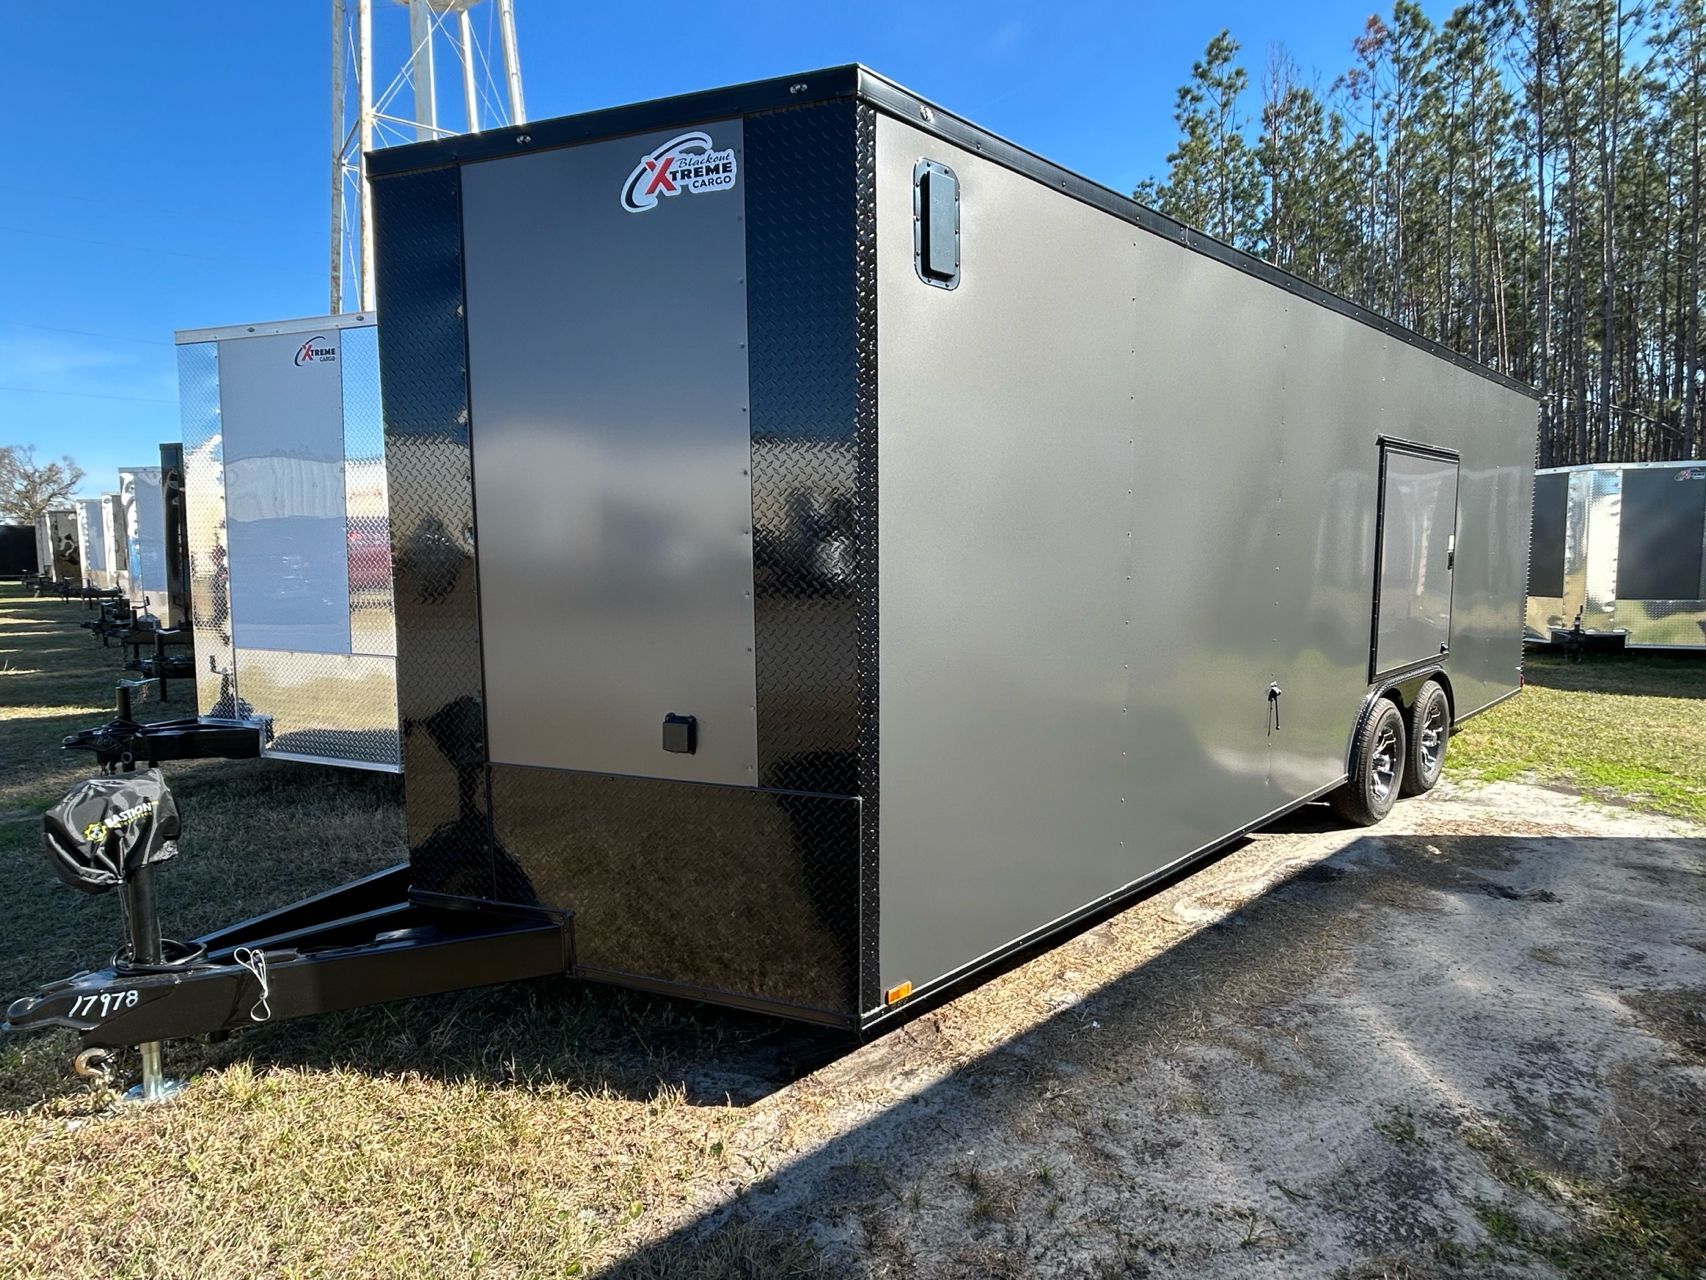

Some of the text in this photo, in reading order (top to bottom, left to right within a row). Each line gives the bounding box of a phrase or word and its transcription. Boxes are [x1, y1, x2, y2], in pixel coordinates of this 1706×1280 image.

[677, 153, 731, 168] Blackout
[645, 156, 732, 195] XTREME
[692, 175, 732, 188] CARGO
[301, 344, 336, 361] XTREME
[68, 990, 139, 1018] 17978
